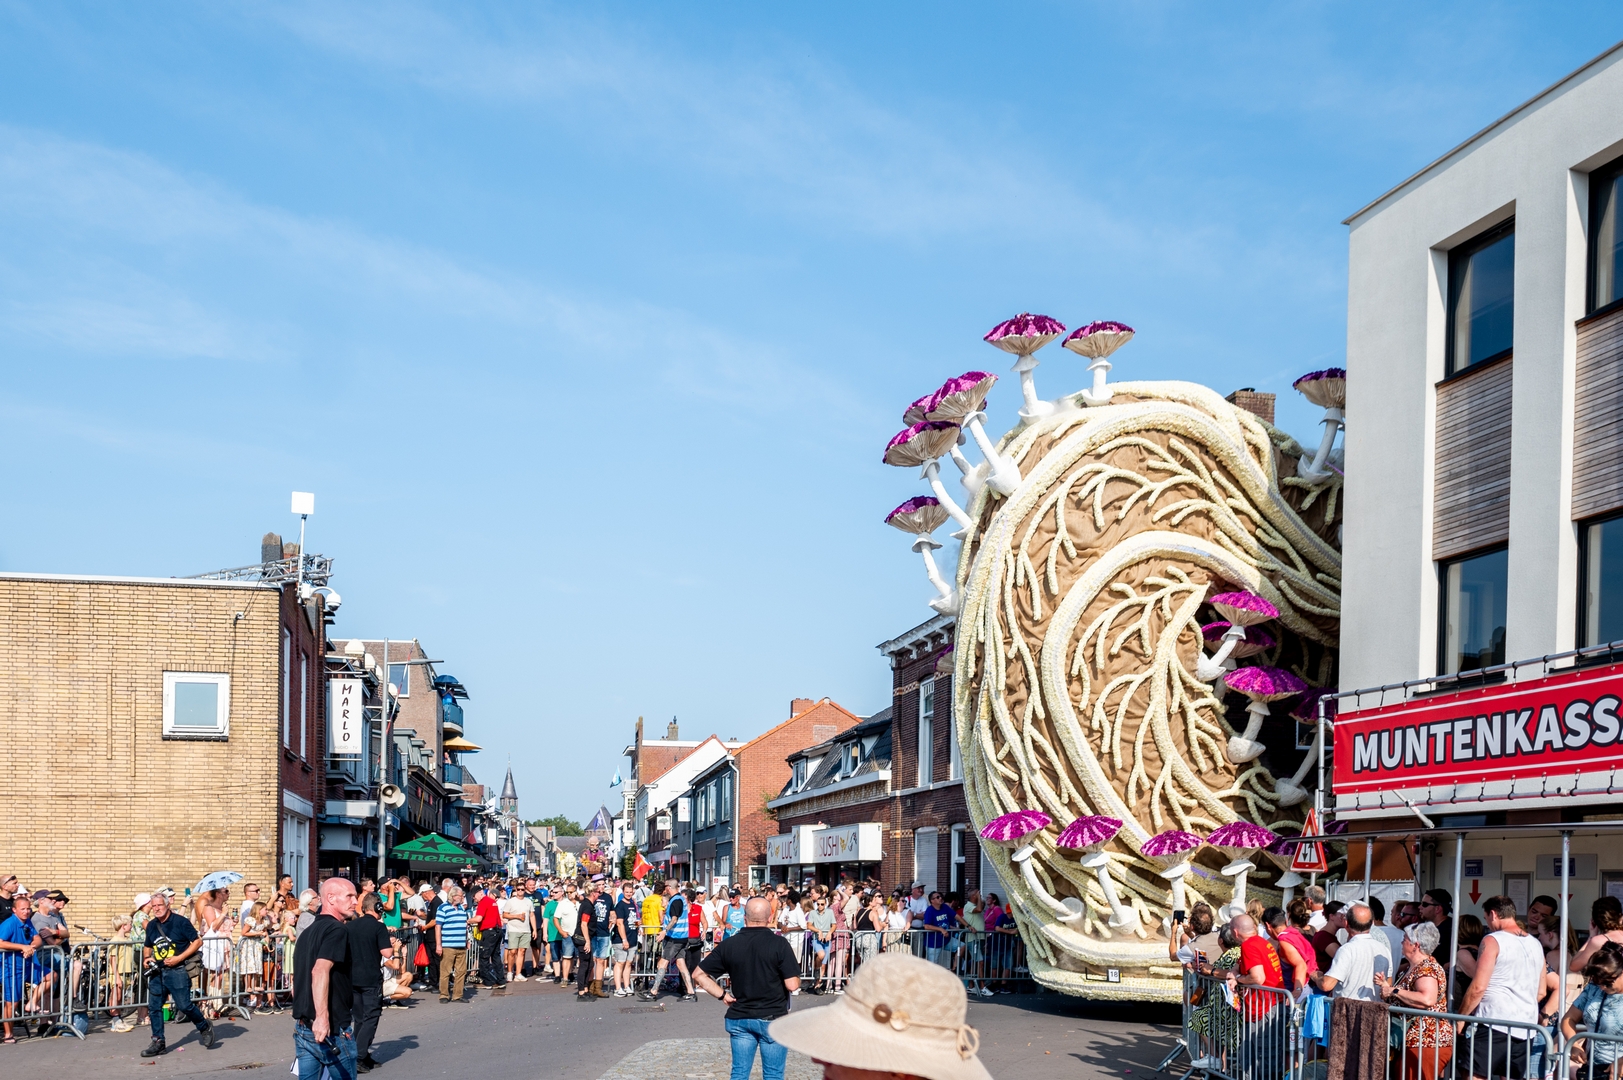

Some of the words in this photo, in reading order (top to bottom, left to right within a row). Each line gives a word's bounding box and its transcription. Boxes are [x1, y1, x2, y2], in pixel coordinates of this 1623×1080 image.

[341, 683, 352, 742] MARLO
[1353, 696, 1623, 773] MUNTENKASS
[389, 851, 479, 865] eineken
[819, 835, 840, 857] SUSHI
